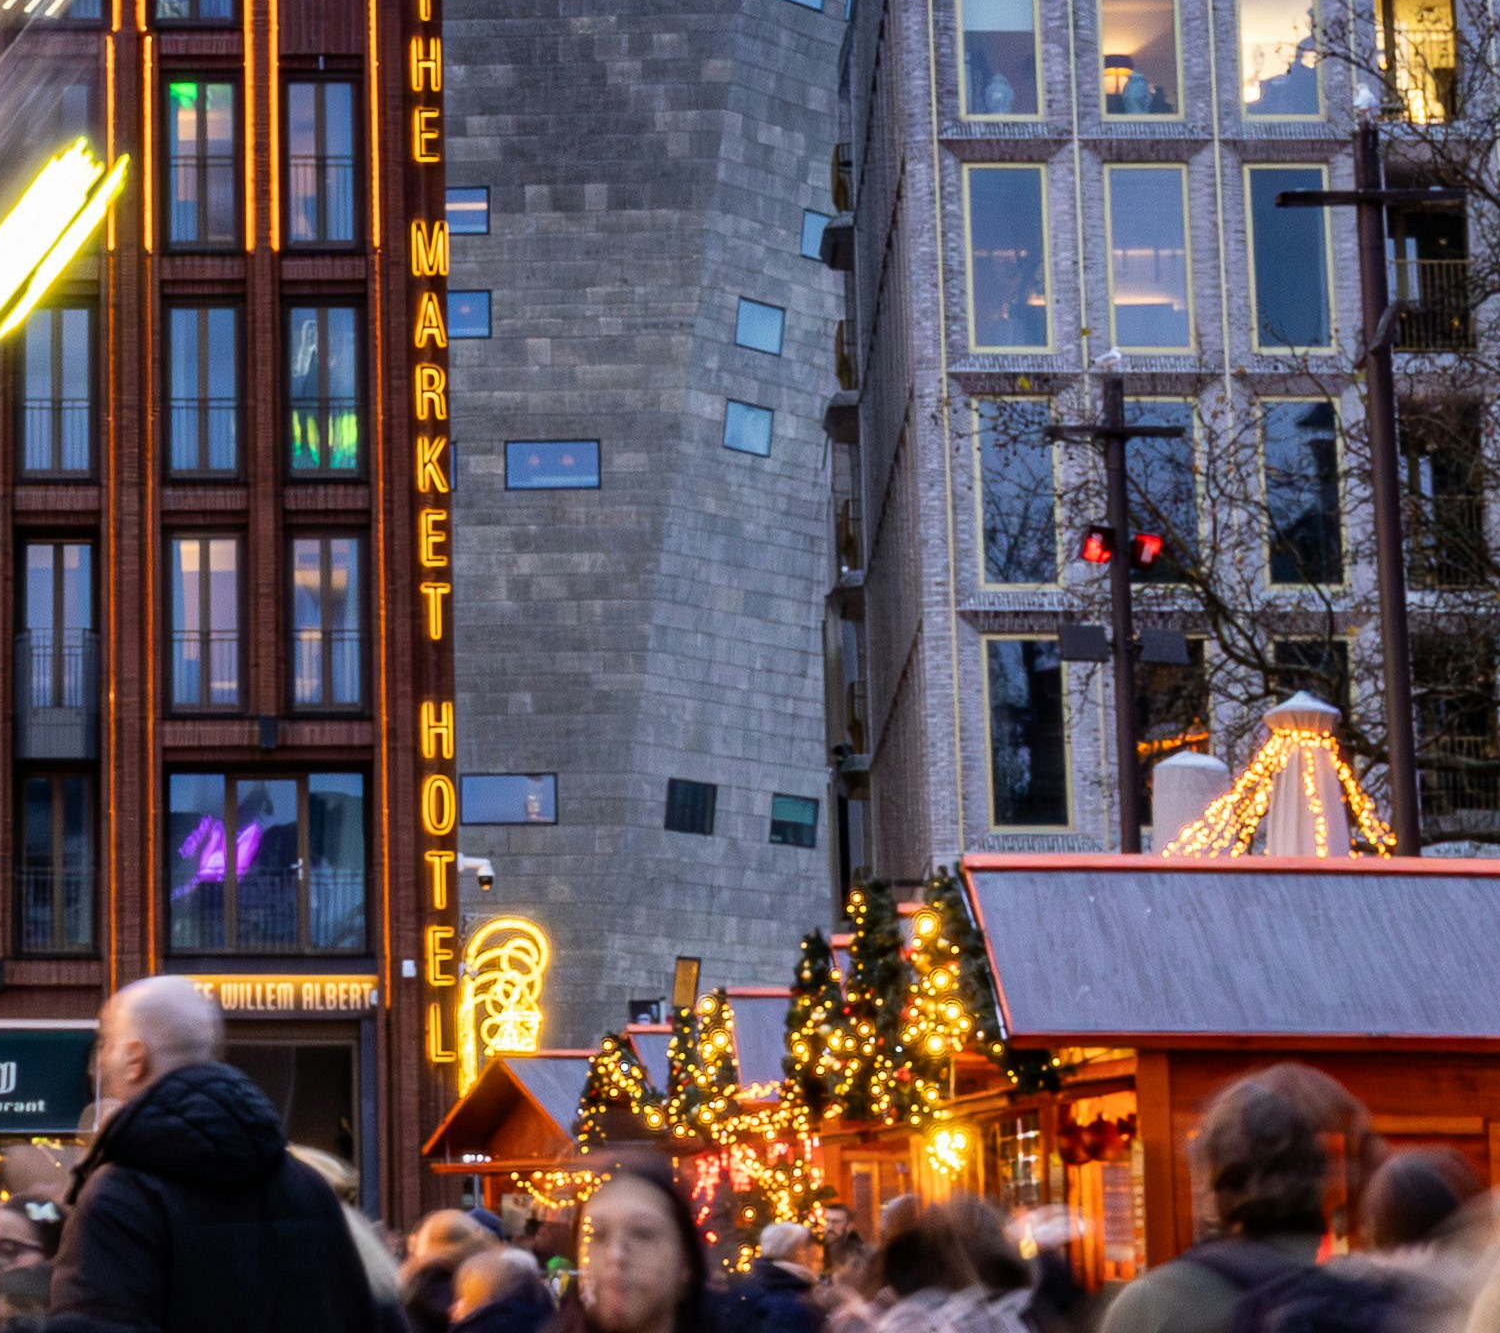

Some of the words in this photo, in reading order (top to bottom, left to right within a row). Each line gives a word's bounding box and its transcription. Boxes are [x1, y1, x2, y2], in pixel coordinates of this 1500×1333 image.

[411, 218, 451, 641] MARKET
[220, 981, 295, 1011] WILLEM
[420, 700, 457, 1064] HOTEL
